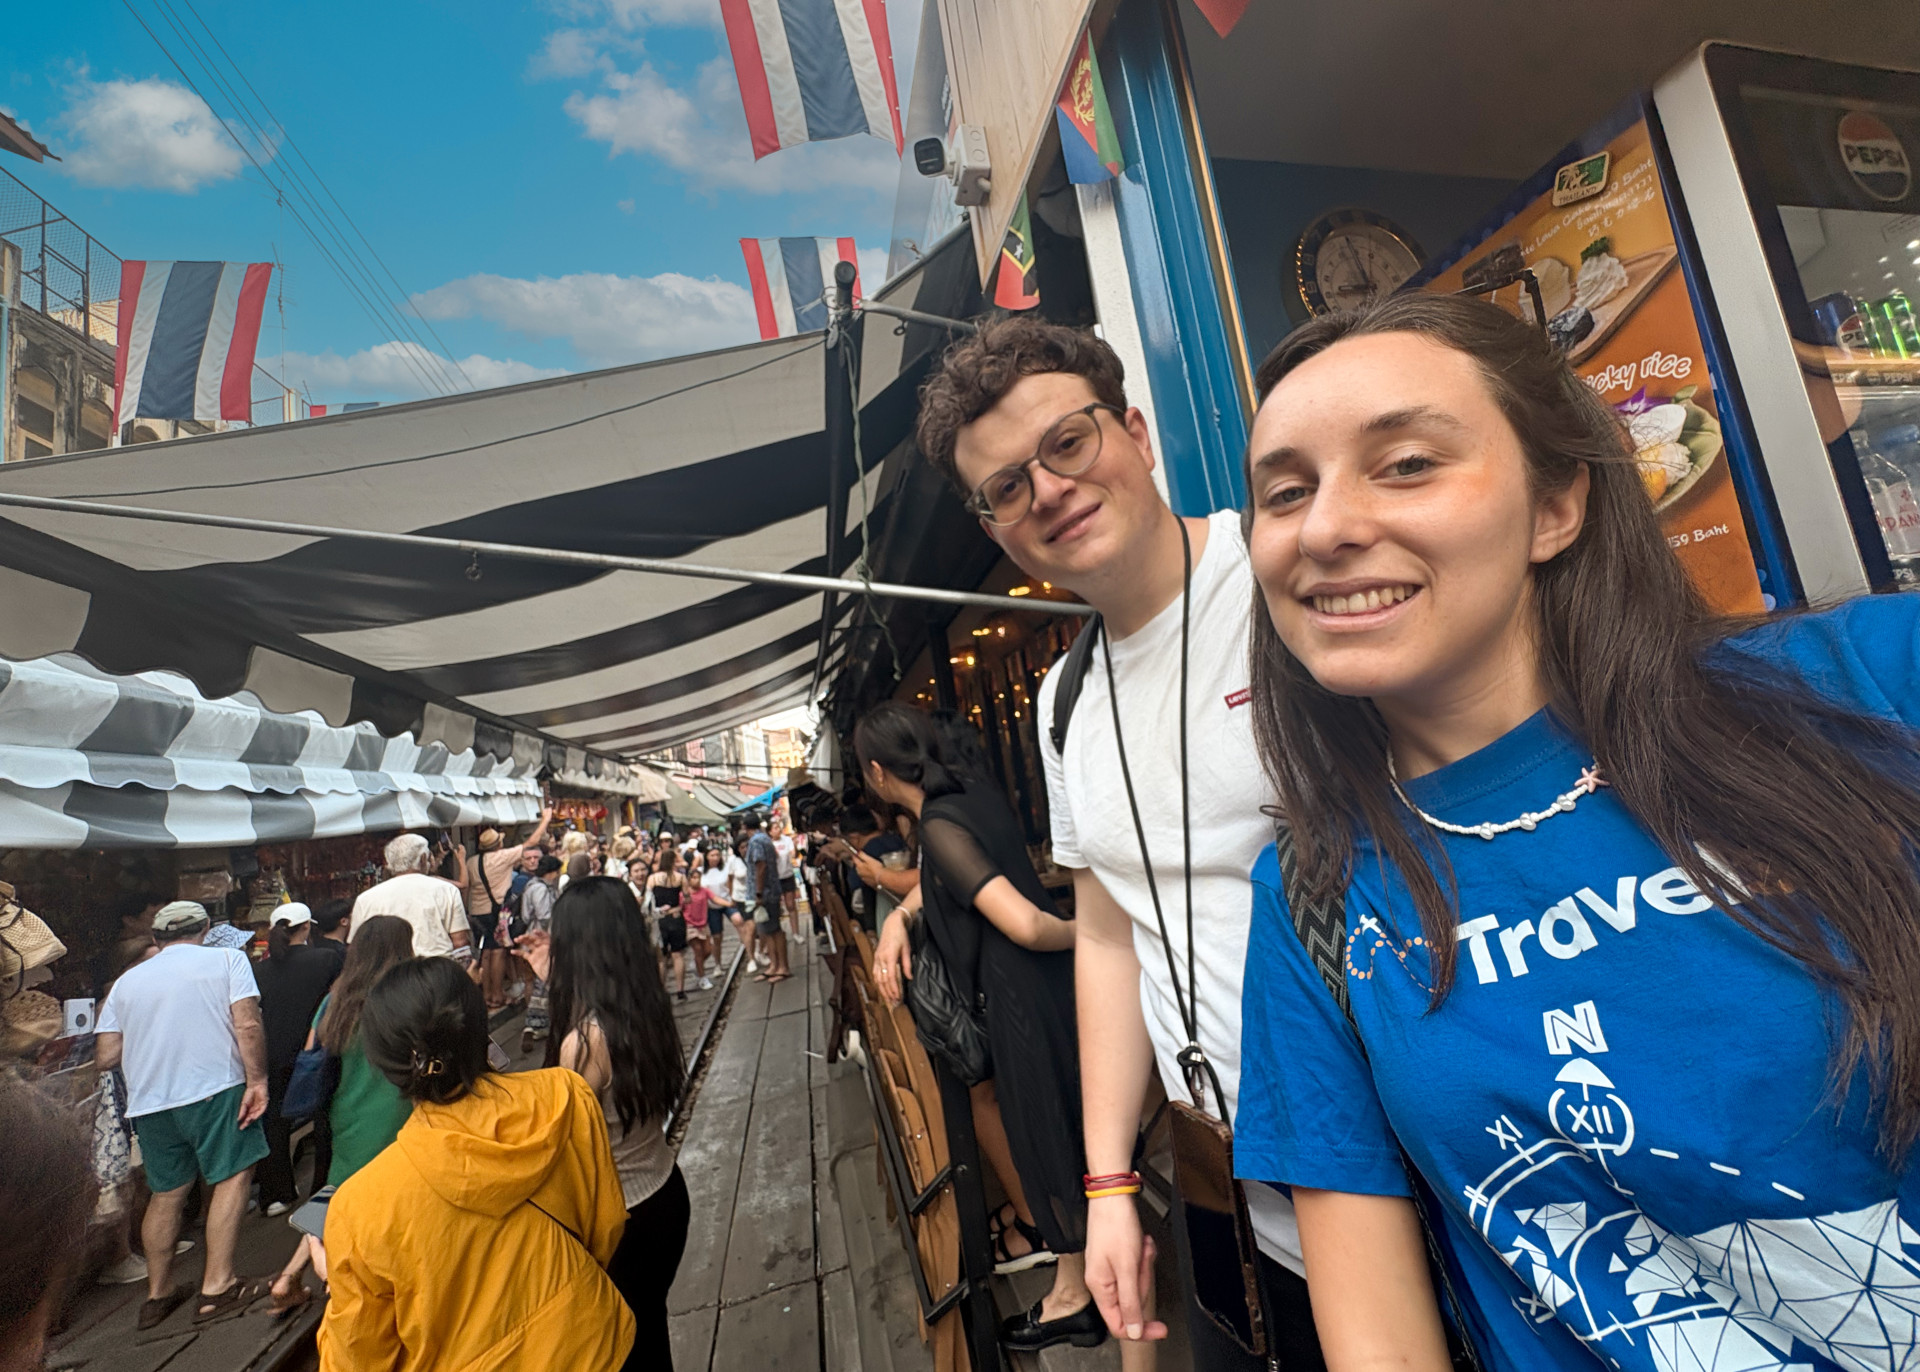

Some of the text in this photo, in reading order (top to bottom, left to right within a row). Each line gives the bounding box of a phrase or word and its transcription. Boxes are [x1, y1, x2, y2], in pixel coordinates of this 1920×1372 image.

[1843, 144, 1906, 168] PEPSI
[1563, 202, 1592, 227] Cake
[1622, 158, 1653, 187] Baht
[1640, 350, 1693, 379] rice
[1693, 522, 1730, 543] Baht
[1542, 1000, 1609, 1055] N
[1485, 1114, 1523, 1150] XI
[1566, 1104, 1614, 1135] XII
